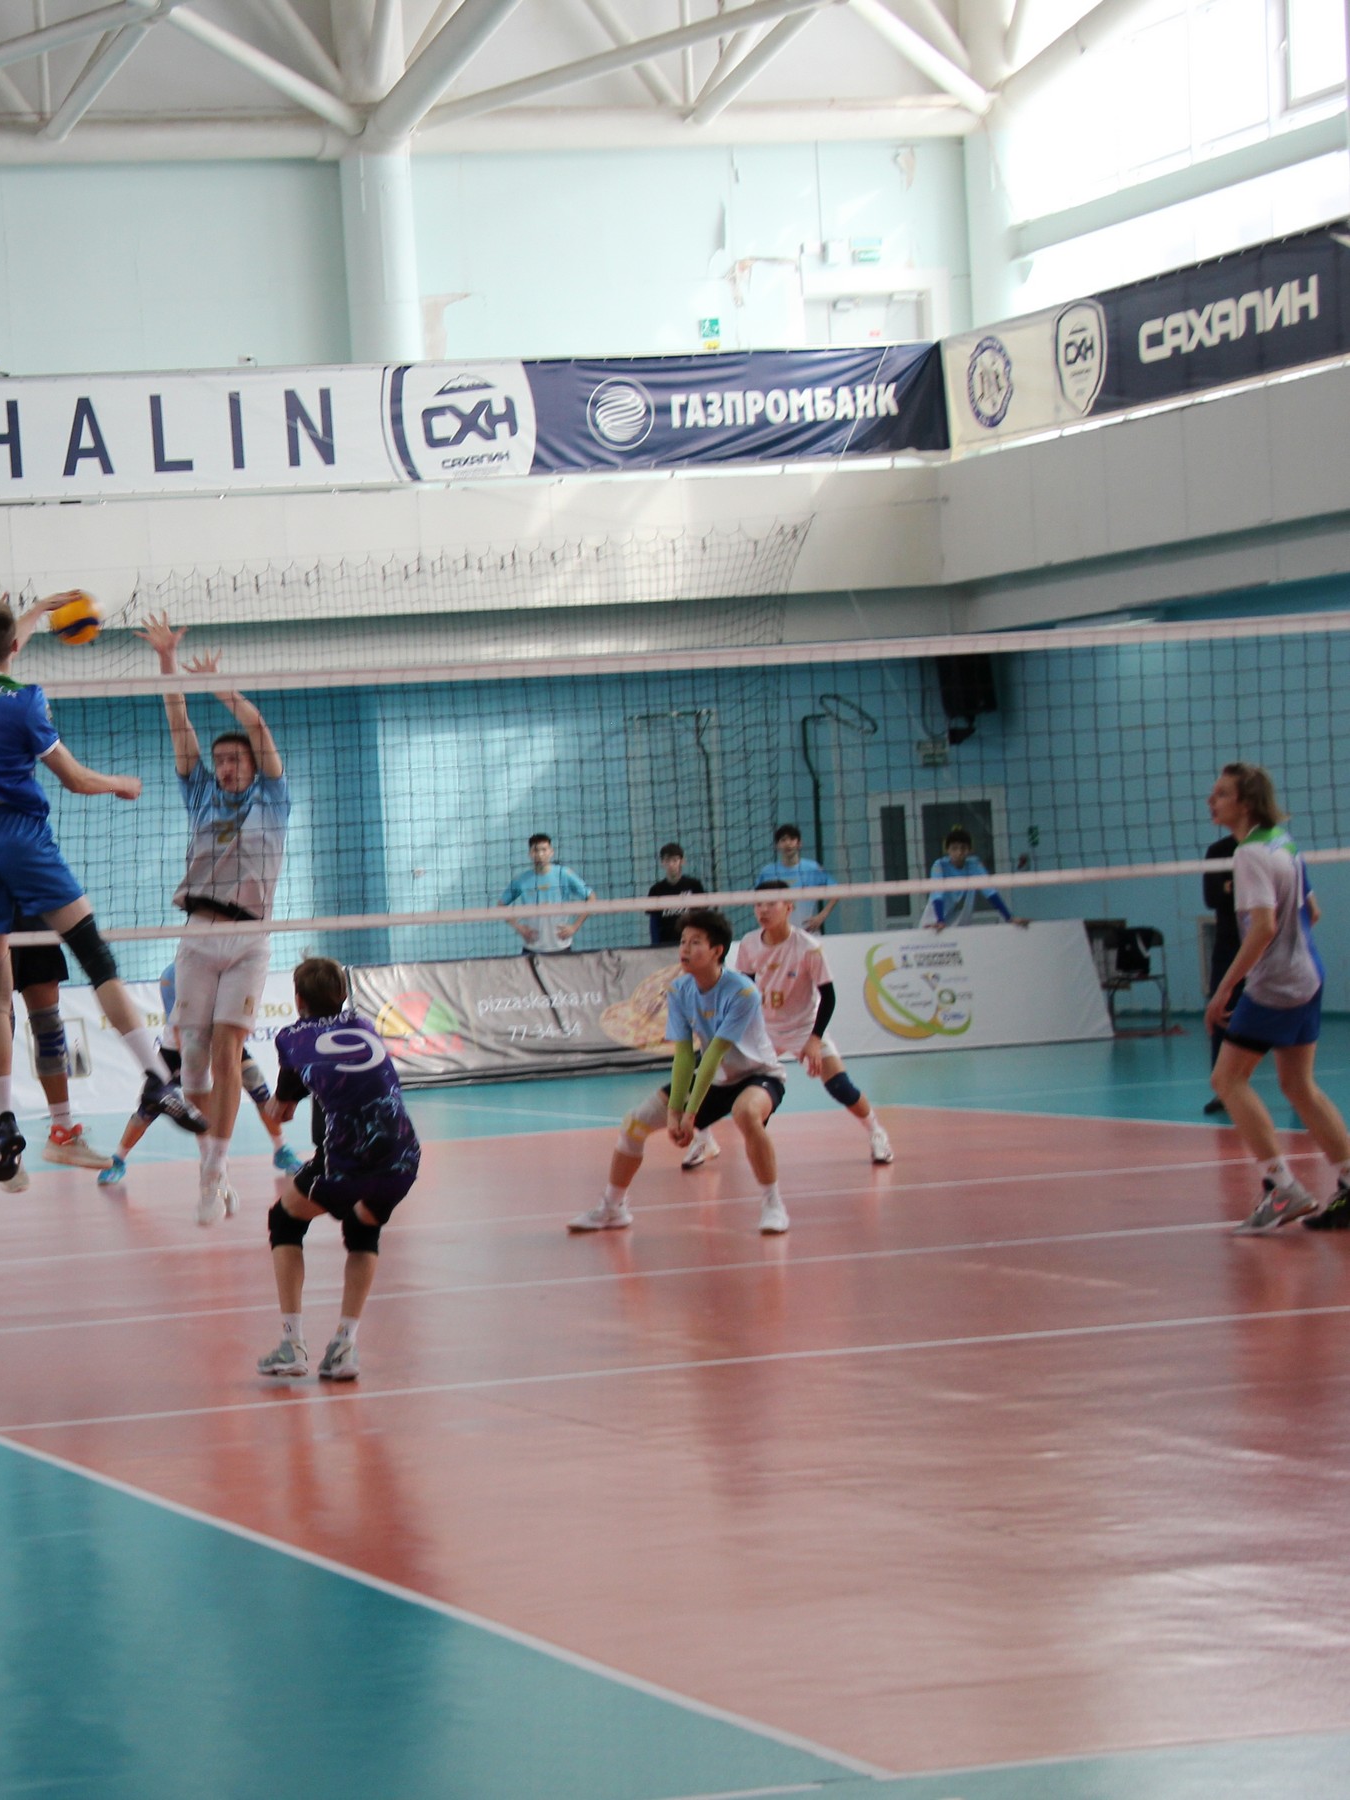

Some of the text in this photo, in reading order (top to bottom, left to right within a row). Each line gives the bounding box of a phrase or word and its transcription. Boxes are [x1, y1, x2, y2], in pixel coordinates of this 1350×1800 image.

[1138, 273, 1320, 364] САХАЛИН
[670, 382, 900, 429] ГАЗПРОМБАНК
[315, 1028, 387, 1072] 9
